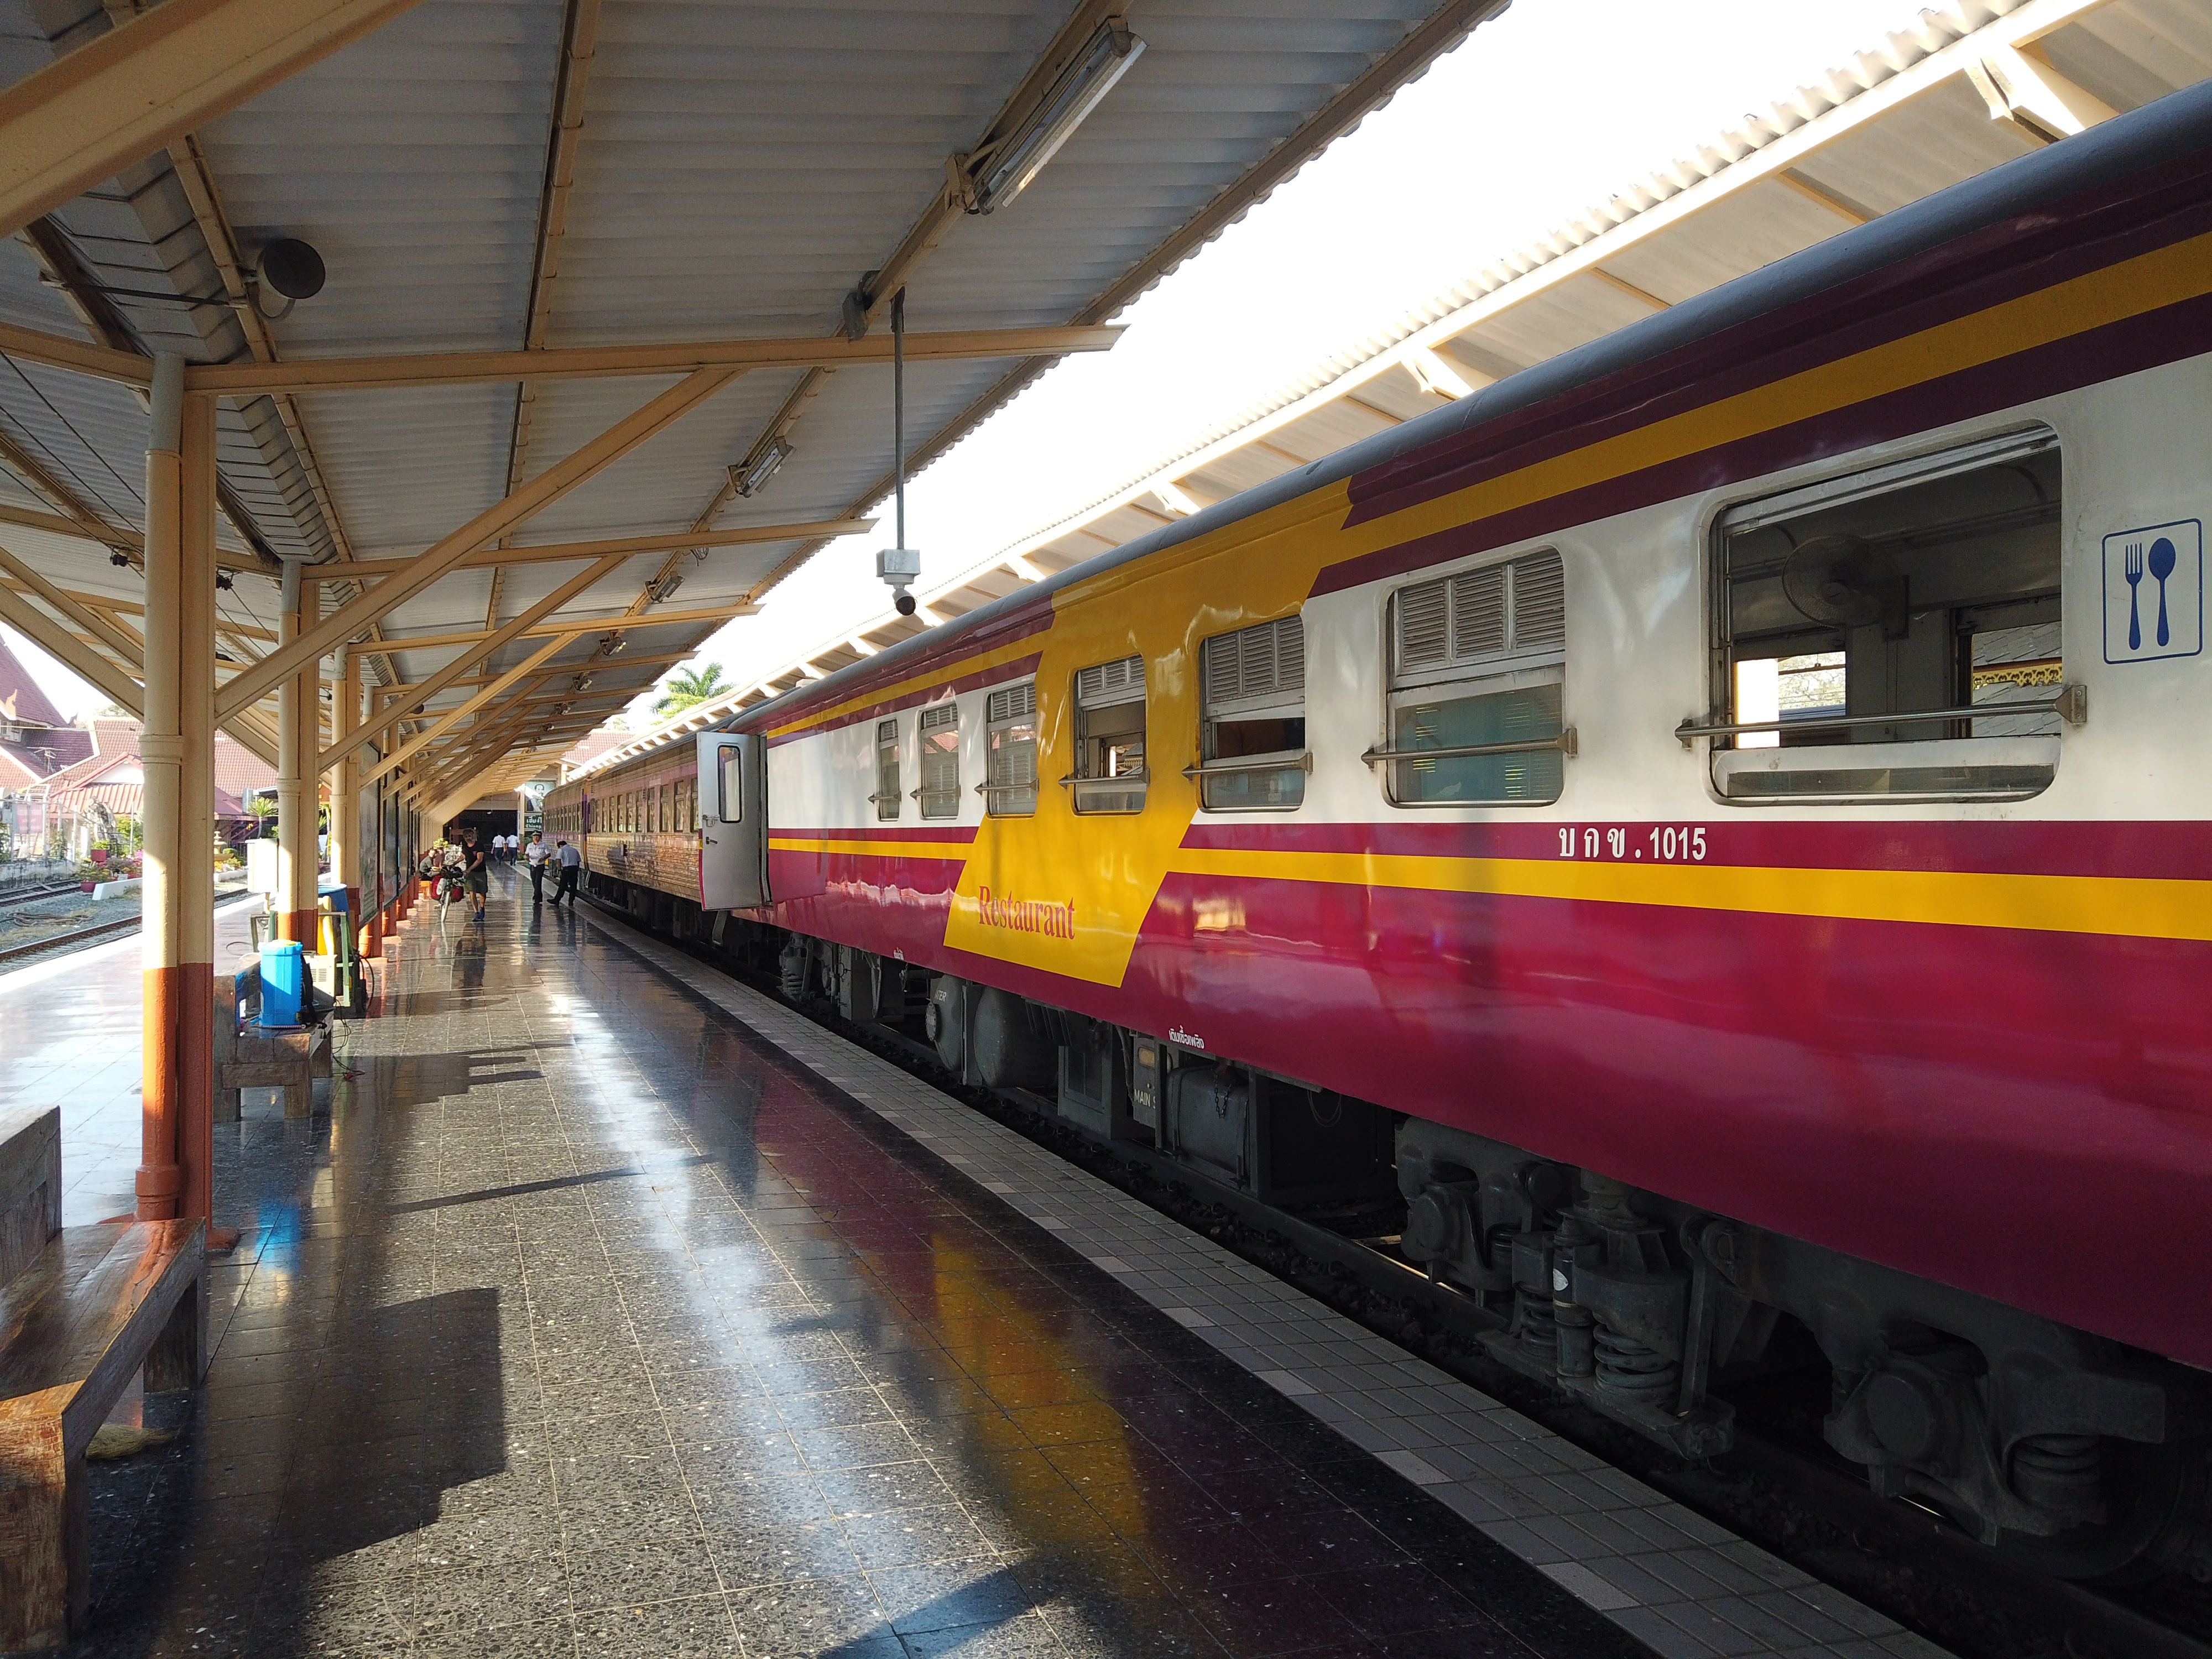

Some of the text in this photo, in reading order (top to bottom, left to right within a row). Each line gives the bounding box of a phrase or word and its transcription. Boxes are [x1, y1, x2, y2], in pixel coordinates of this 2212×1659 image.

[1650, 827, 1706, 860] 1015
[979, 885, 1076, 940] Restaurant
[934, 990, 947, 1002] ATER
[1168, 1025, 1204, 1049] เติมเชื้อเพลิง
[1134, 1088, 1151, 1107] MAIN
